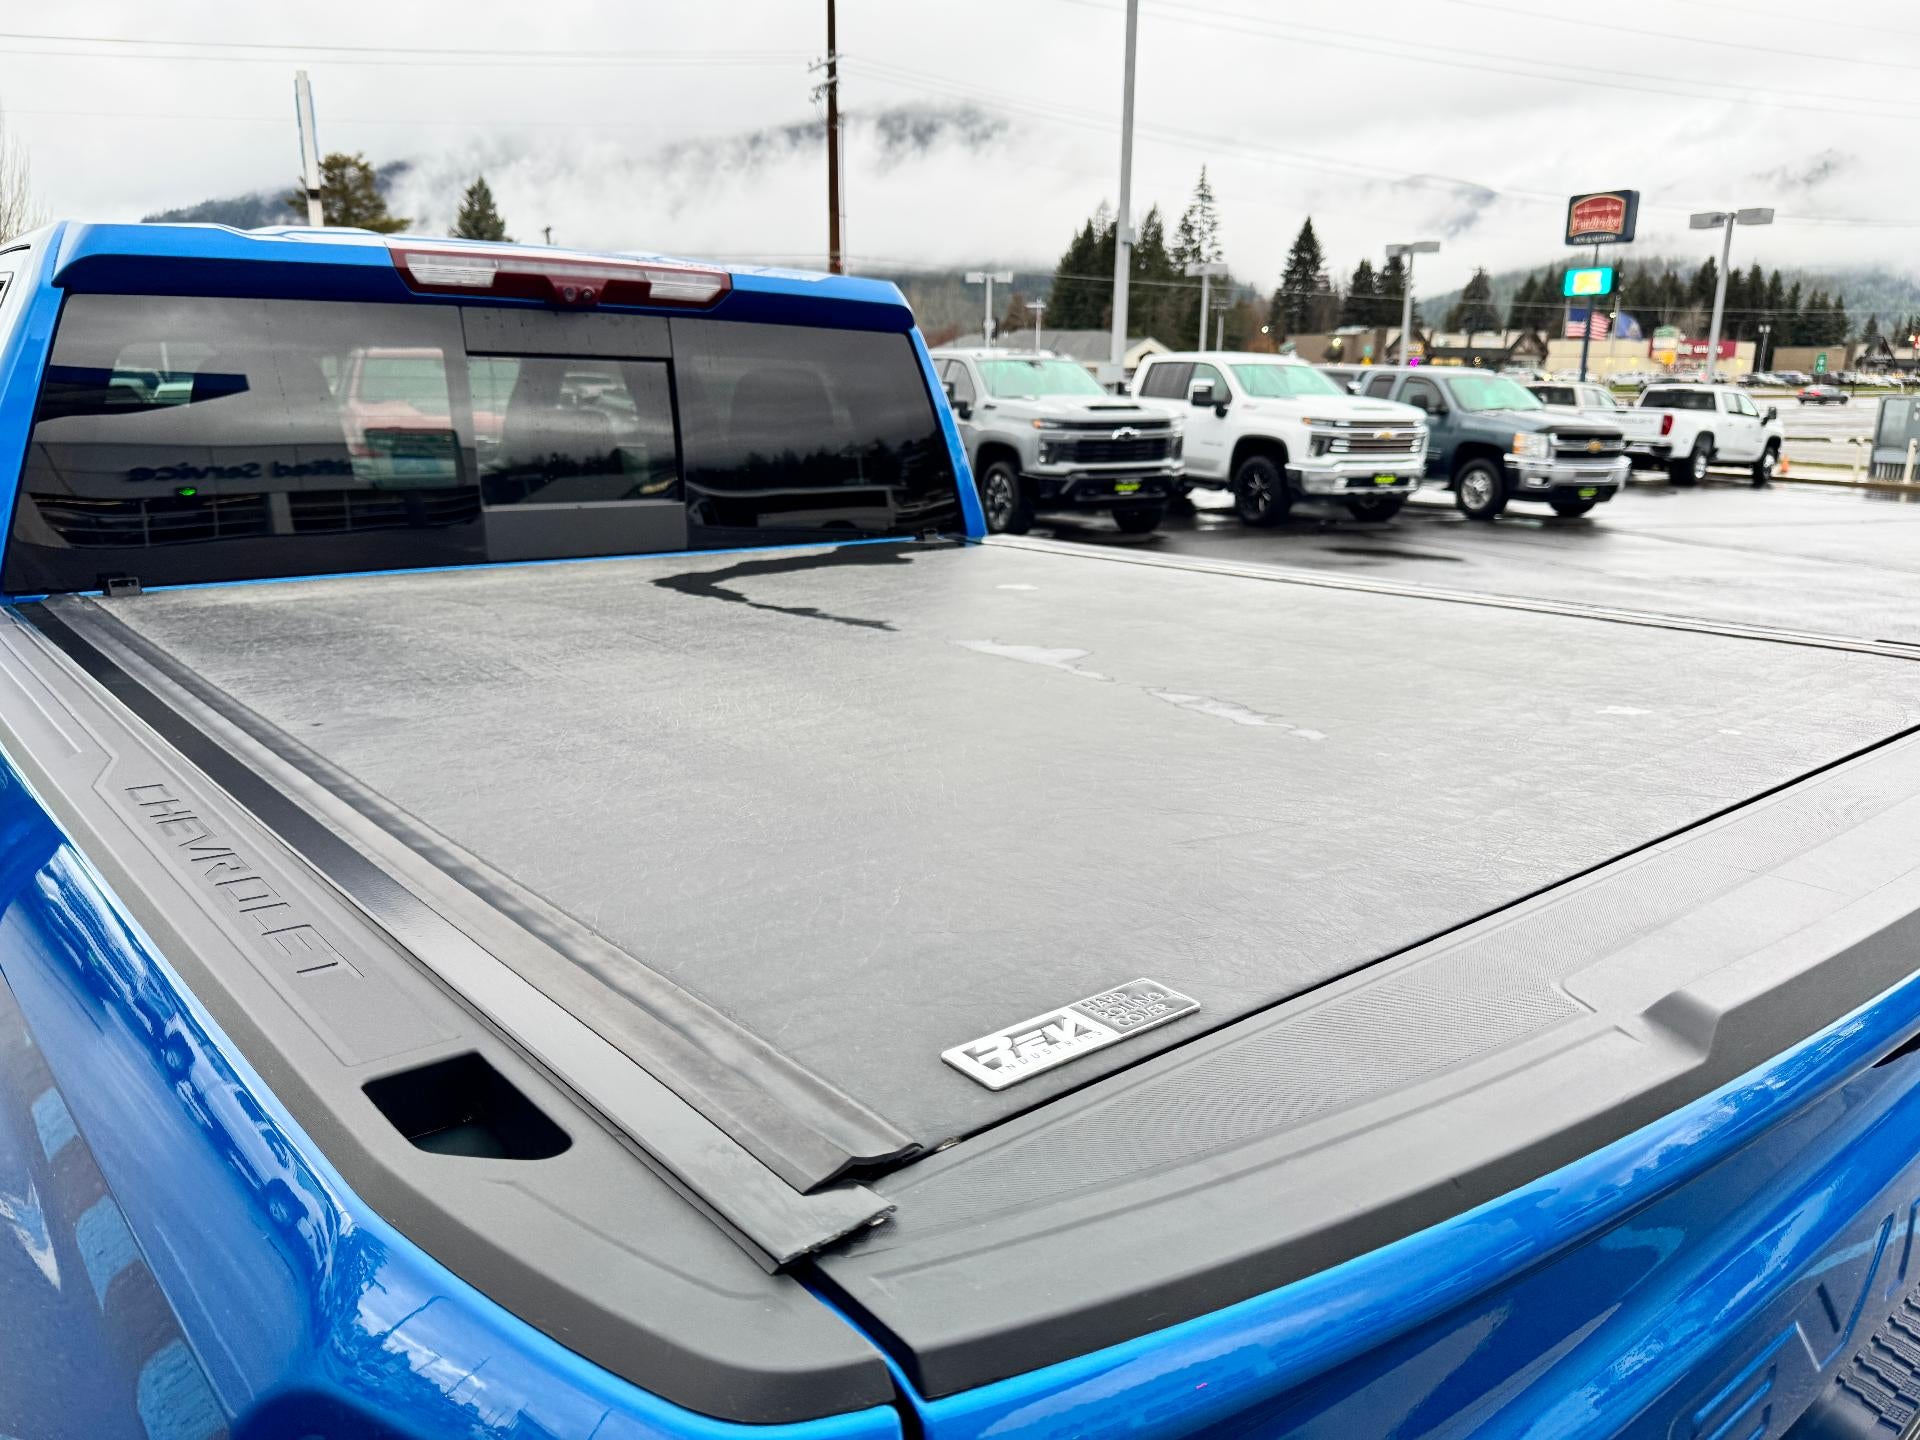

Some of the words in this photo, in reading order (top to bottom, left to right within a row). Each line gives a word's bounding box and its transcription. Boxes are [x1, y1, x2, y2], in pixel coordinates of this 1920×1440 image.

[125, 784, 364, 977] CHEVROLET
[1081, 992, 1127, 1012] HARD
[1098, 992, 1164, 1018] ROLLING
[1116, 1003, 1172, 1026] COVER
[997, 1030, 1103, 1074] INDUSTRIES
